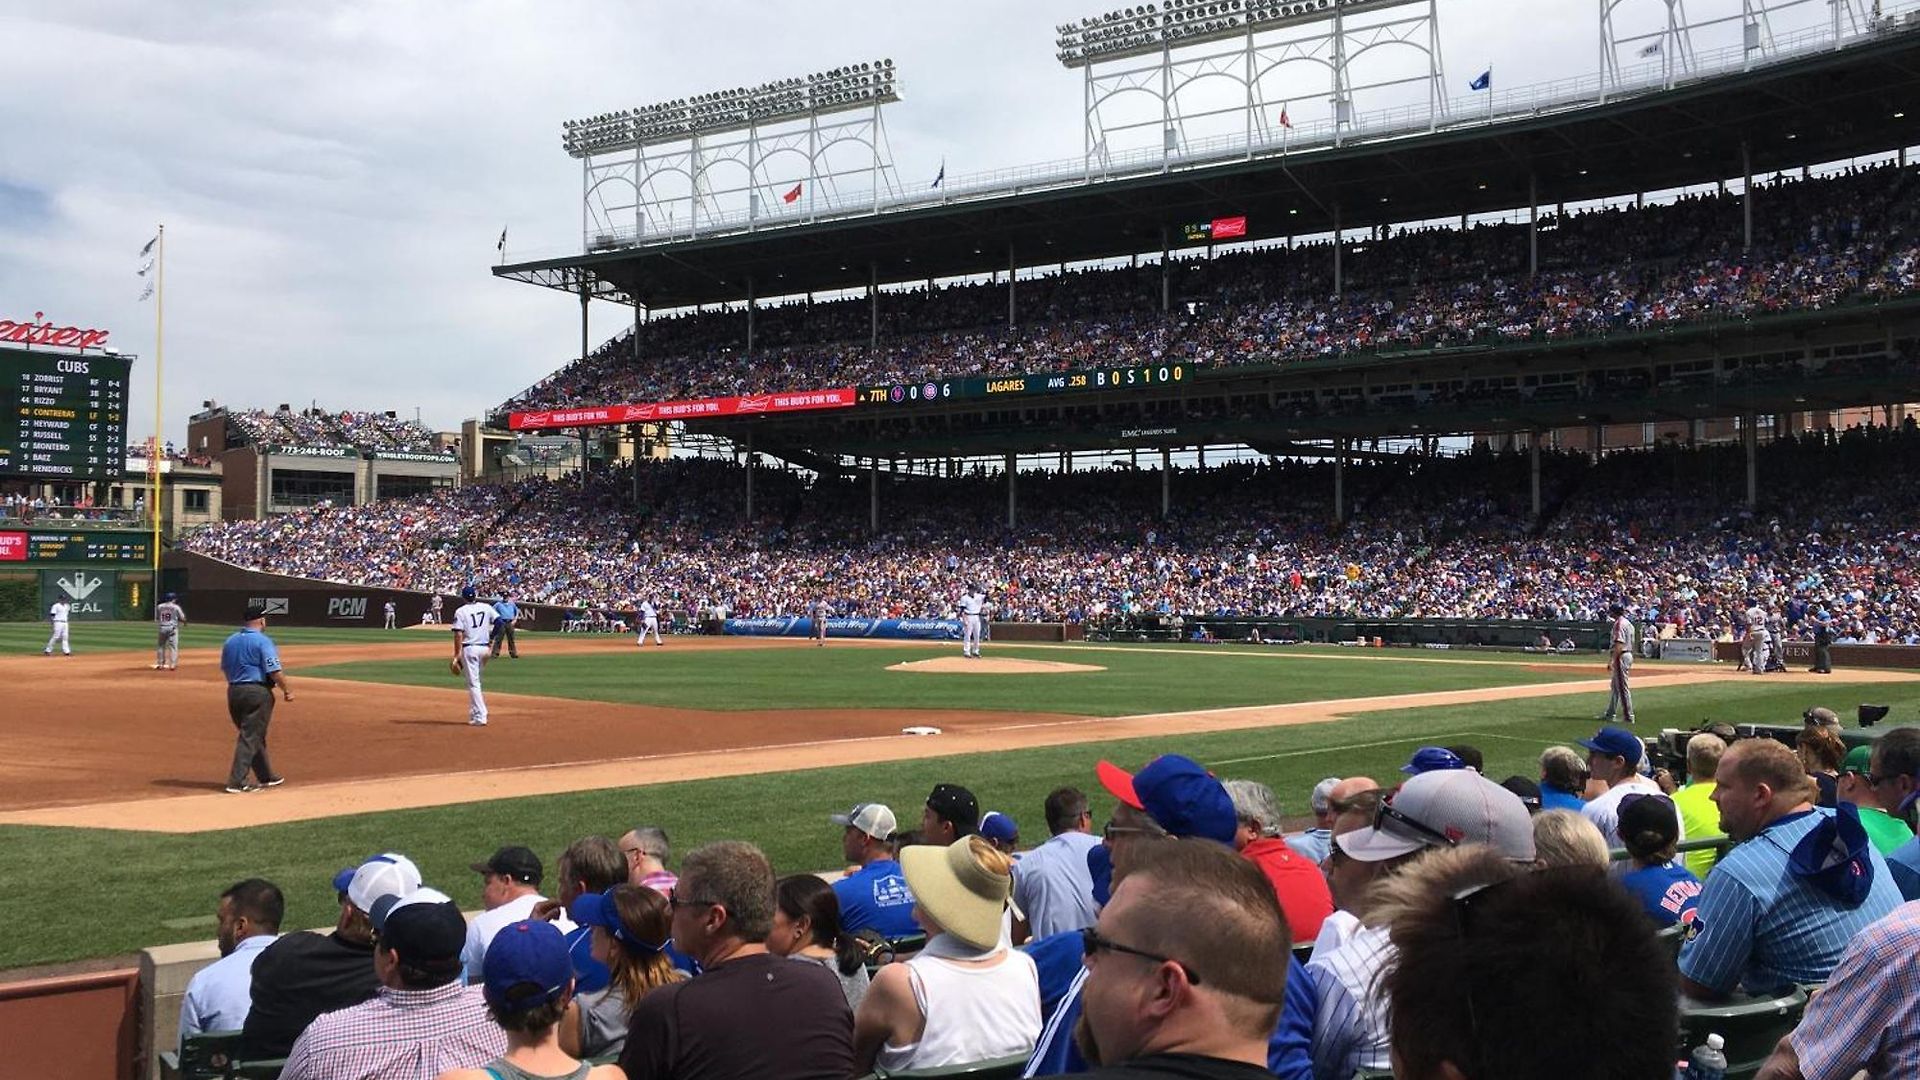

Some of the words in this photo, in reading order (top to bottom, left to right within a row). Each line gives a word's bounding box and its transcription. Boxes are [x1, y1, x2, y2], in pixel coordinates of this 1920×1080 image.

[57, 360, 89, 374] CUBS
[34, 374, 64, 383] ZOBRIST
[90, 378, 99, 386] RF
[1097, 372, 1105, 385] B
[1111, 371, 1120, 385] 0
[1127, 370, 1135, 384] S
[1143, 369, 1151, 383] 1
[1159, 367, 1169, 382] O
[1174, 366, 1183, 381] 0
[986, 379, 1025, 393] LAGARES
[1047, 378, 1065, 388] AVG
[1068, 376, 1087, 387] .258
[34, 386, 63, 394] BRYANT
[870, 389, 887, 402] 7TH
[910, 386, 917, 400] 0
[943, 384, 950, 397] 6
[34, 397, 55, 405] RIZZO
[775, 398, 790, 407] THIS
[790, 396, 811, 406] BUD'S
[811, 395, 825, 404] FOR
[826, 394, 842, 403] YOU.
[34, 408, 75, 418] CONTRERAS
[659, 406, 672, 414] THIS
[673, 405, 691, 414] BUD'S
[692, 404, 704, 413] FOR
[583, 411, 595, 420] FOR
[20, 419, 29, 427] 22
[33, 420, 70, 429] HEYWARD
[33, 431, 62, 439] RUSSELL
[33, 442, 70, 451] MONTERO
[89, 445, 94, 453] C
[32, 453, 51, 461] BAEZ
[32, 464, 73, 474] HENDRICKS
[328, 597, 368, 616] PCM
[470, 611, 485, 629] 17
[733, 620, 766, 630] Reynolds
[766, 620, 786, 630] Wrap
[847, 620, 869, 630] Wrap
[897, 621, 935, 631] Reynolds
[934, 621, 959, 632] Wrap
